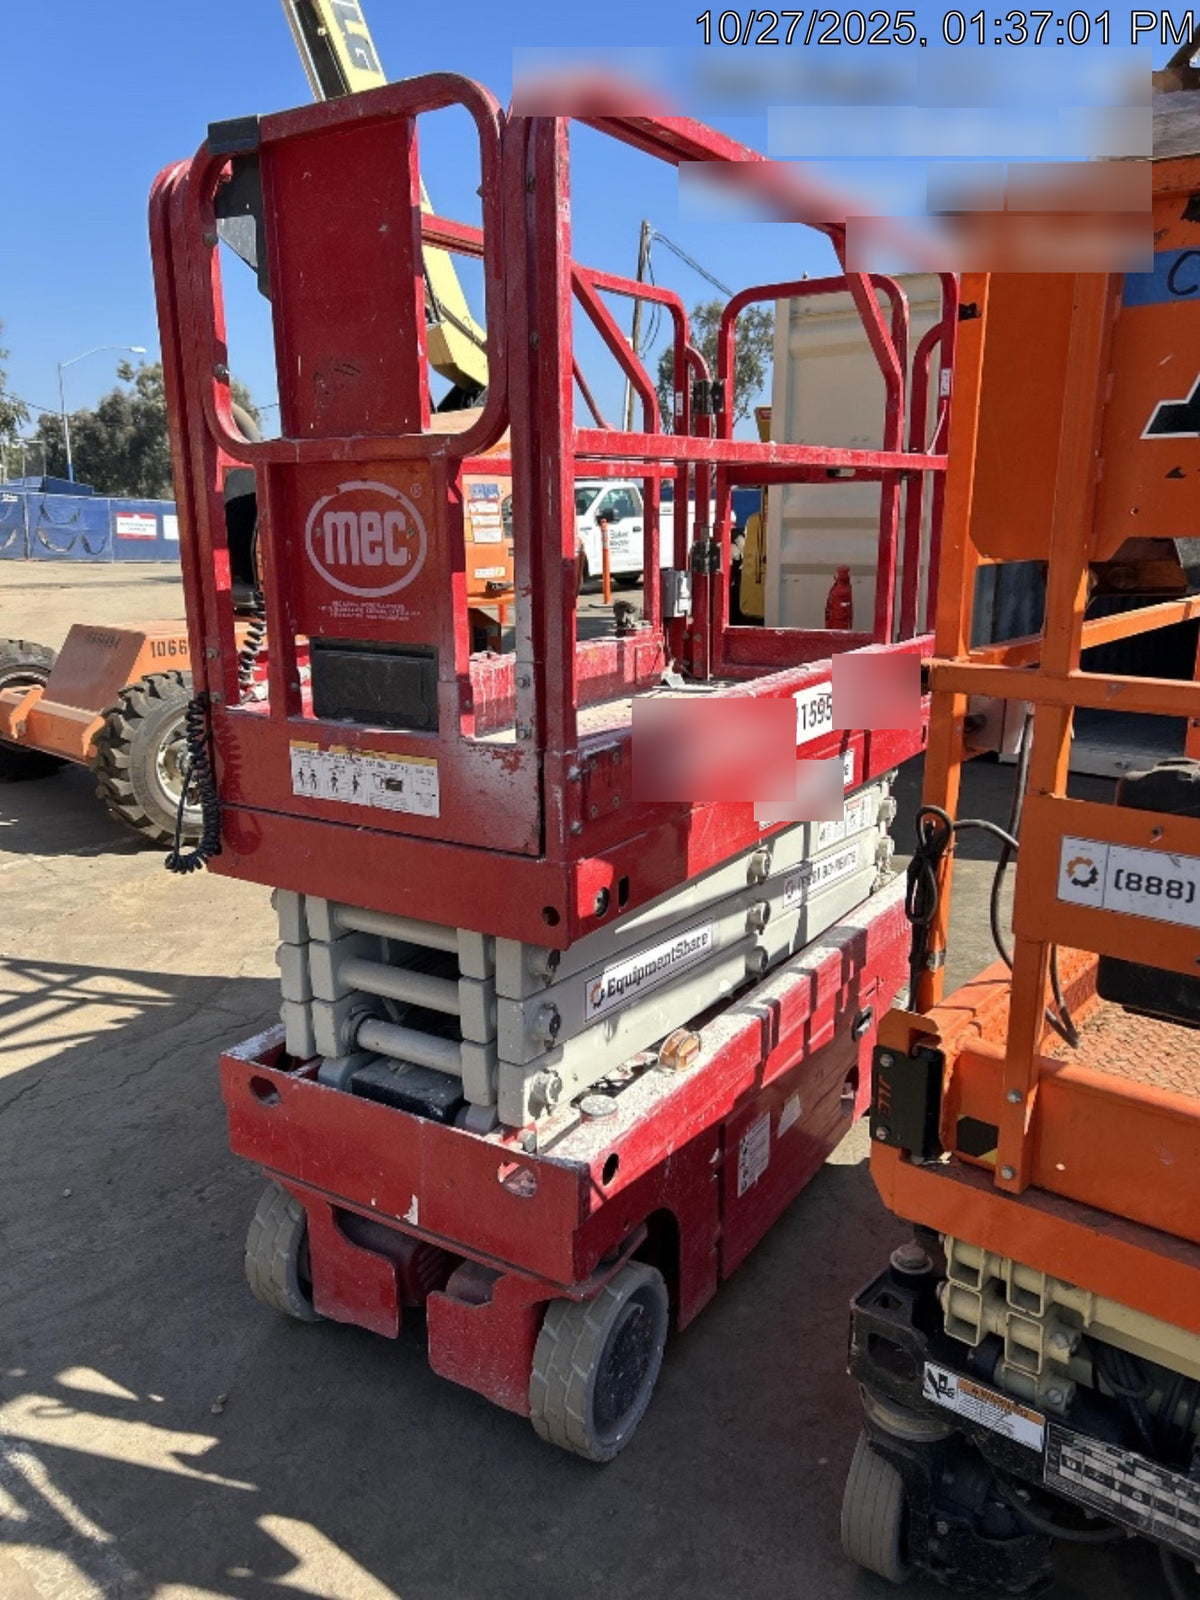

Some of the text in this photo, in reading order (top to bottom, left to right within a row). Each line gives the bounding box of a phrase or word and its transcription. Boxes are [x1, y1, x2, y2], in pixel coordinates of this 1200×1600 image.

[796, 692, 833, 731] 1595
[1114, 868, 1196, 904] (888)
[607, 931, 709, 999] EquipmentShare
